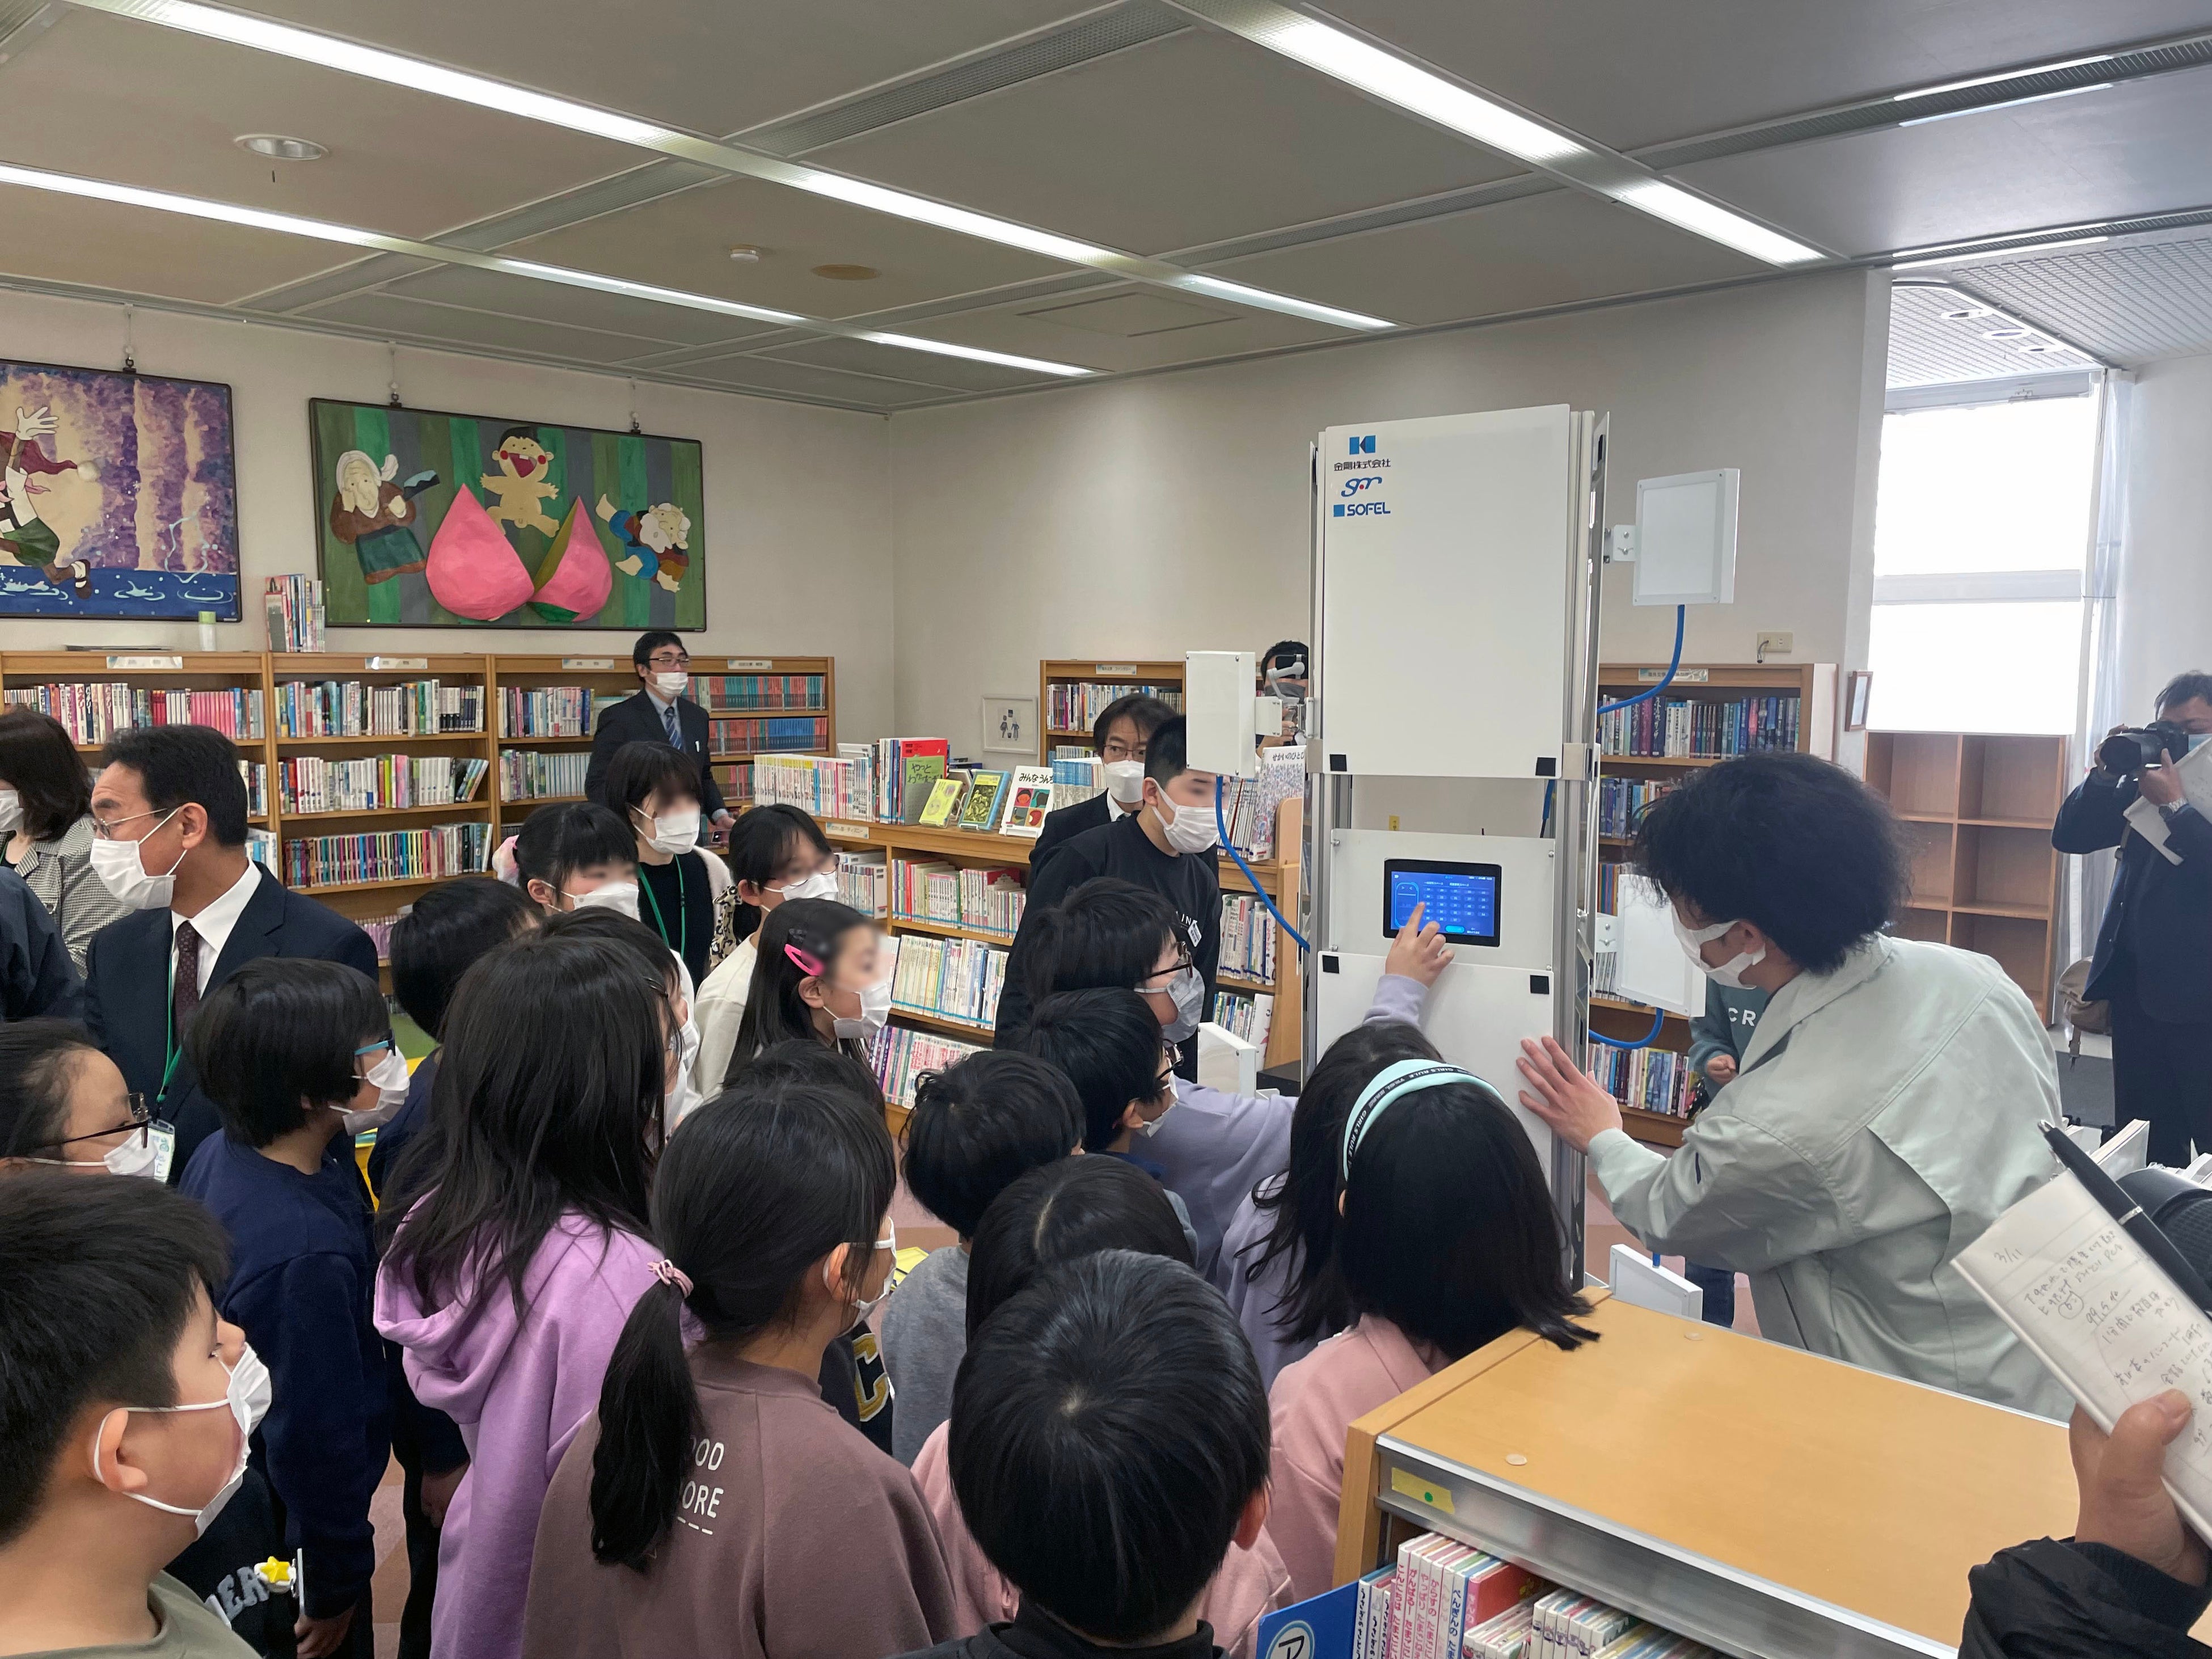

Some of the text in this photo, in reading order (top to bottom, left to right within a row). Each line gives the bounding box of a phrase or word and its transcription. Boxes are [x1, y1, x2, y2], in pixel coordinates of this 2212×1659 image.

[1334, 458, 1391, 471] 金剛株式会社
[1347, 502, 1391, 517] SOFEL
[1176, 911, 1192, 925] IN
[1354, 1109, 1367, 1134] GIRLS
[690, 1434, 724, 1471] OD
[1395, 1564, 1404, 1611] こんにちは
[1449, 1589, 1462, 1637] ぺんぎんの
